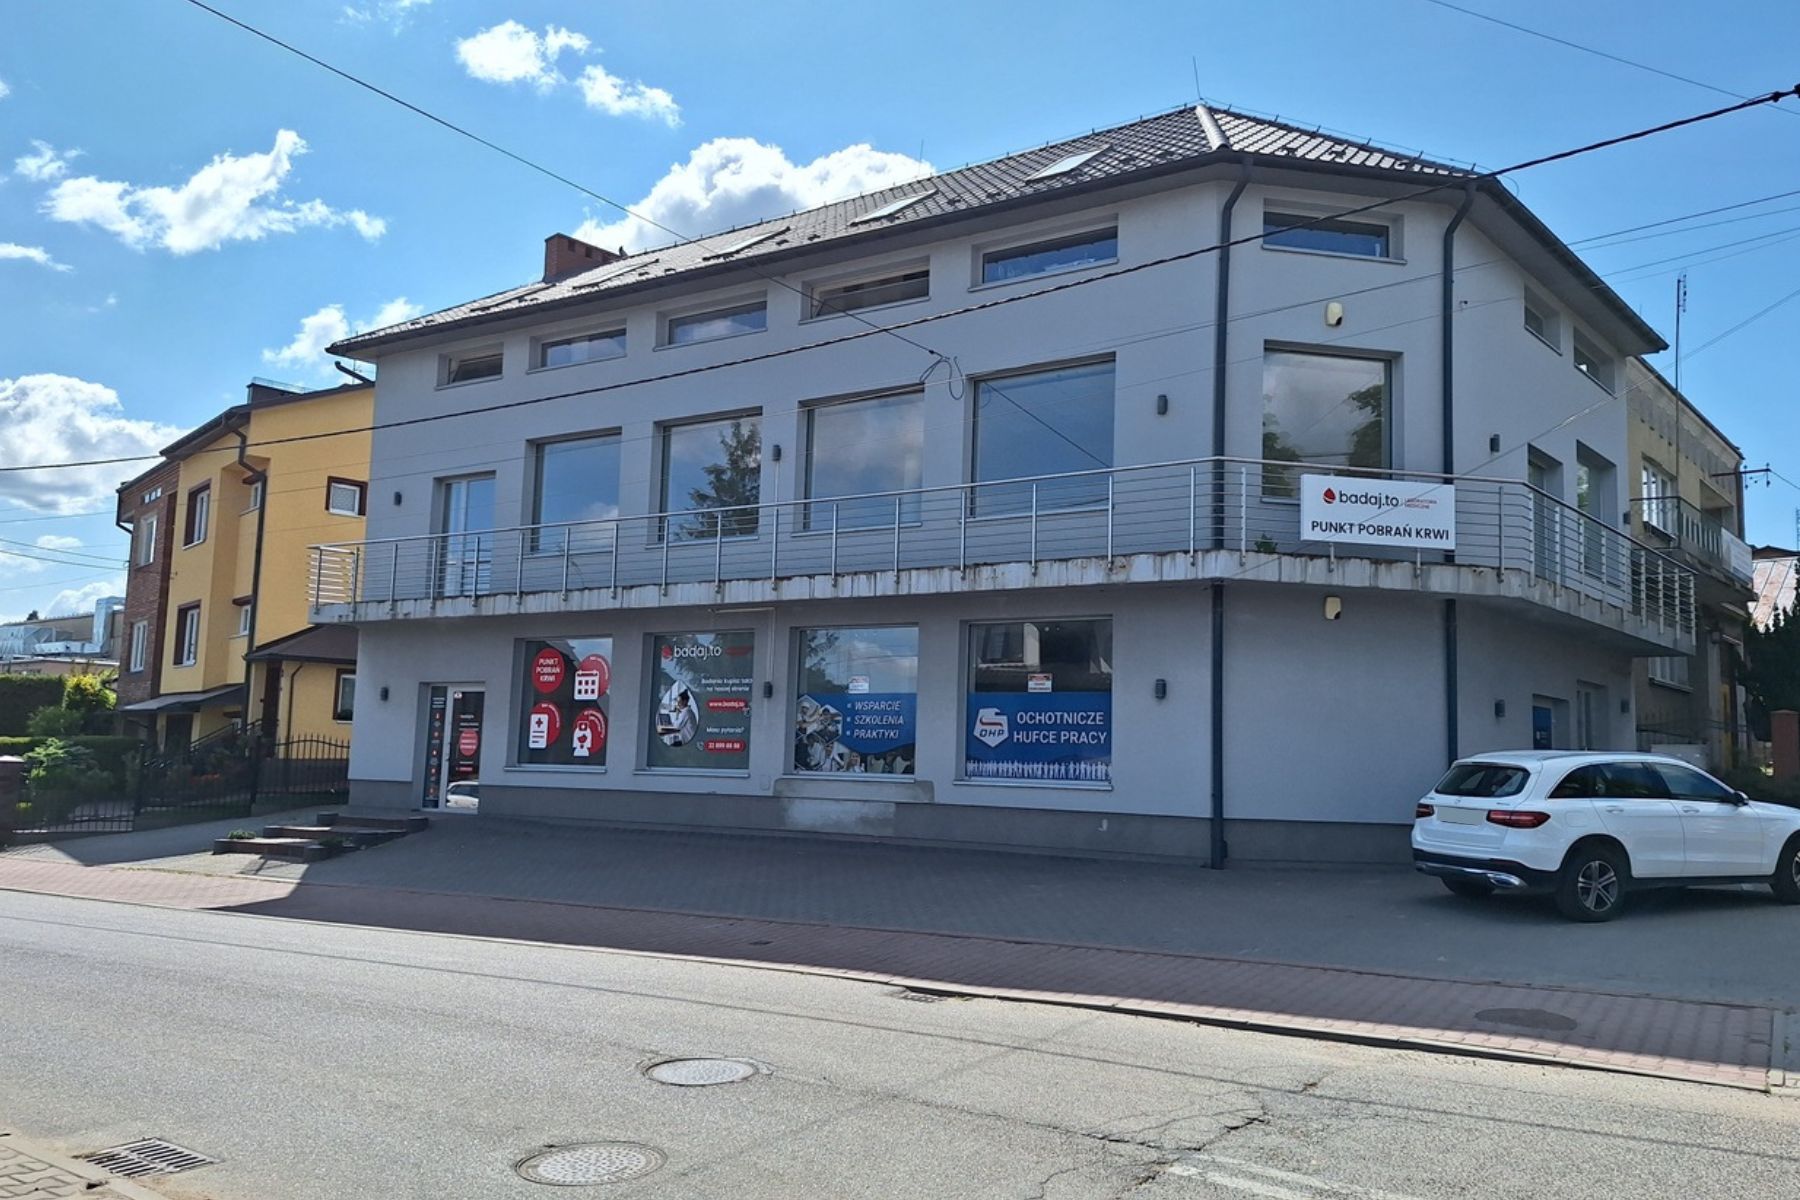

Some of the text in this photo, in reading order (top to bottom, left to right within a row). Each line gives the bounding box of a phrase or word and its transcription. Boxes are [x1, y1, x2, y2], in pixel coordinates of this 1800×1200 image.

[1339, 490, 1399, 509] badaj.to
[1311, 520, 1449, 541] PUNKT POBRAŃ KRWI
[674, 645, 721, 660] badaj.to
[538, 657, 559, 665] PUNKT
[854, 700, 901, 711] WSPARCIE
[853, 715, 904, 725] SZKOLENIA
[1017, 711, 1104, 725] OCHOTNICZE
[853, 729, 899, 739] PRAKTYKI
[980, 729, 1005, 738] OHP
[1013, 730, 1107, 744] HUFCE PRACY
